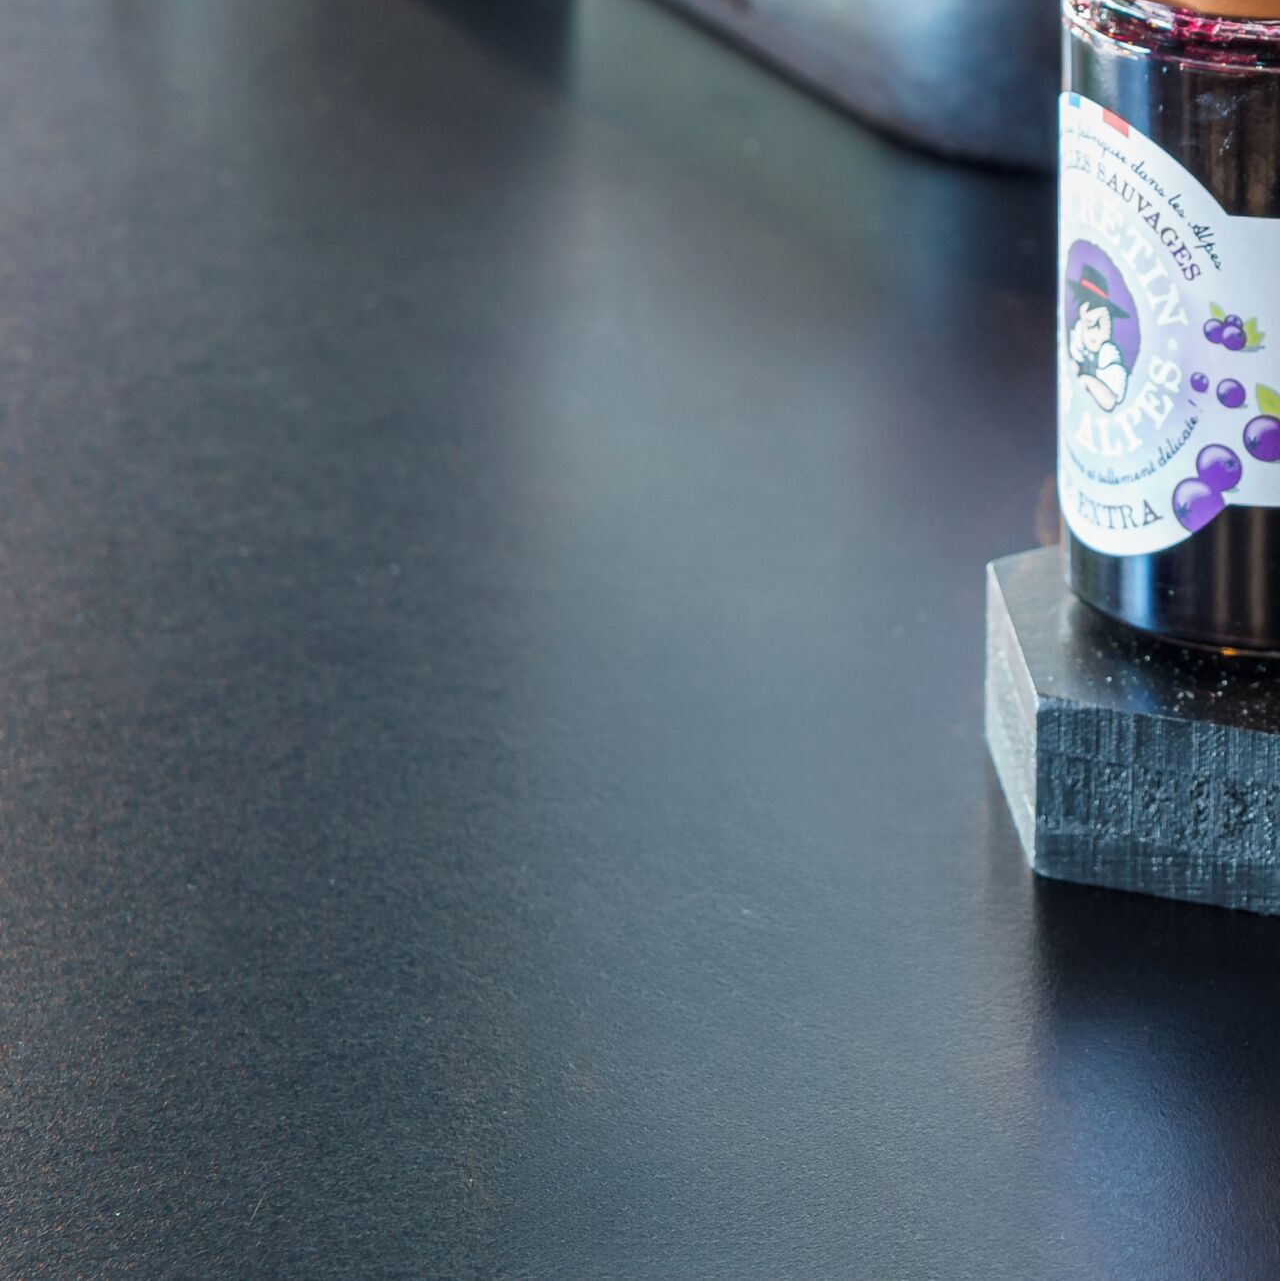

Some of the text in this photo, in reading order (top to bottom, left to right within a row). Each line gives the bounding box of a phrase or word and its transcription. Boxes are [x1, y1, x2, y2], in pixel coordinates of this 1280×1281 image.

[1097, 162, 1202, 282] SAUVAGES
[1131, 160, 1222, 270] dans les Alpes
